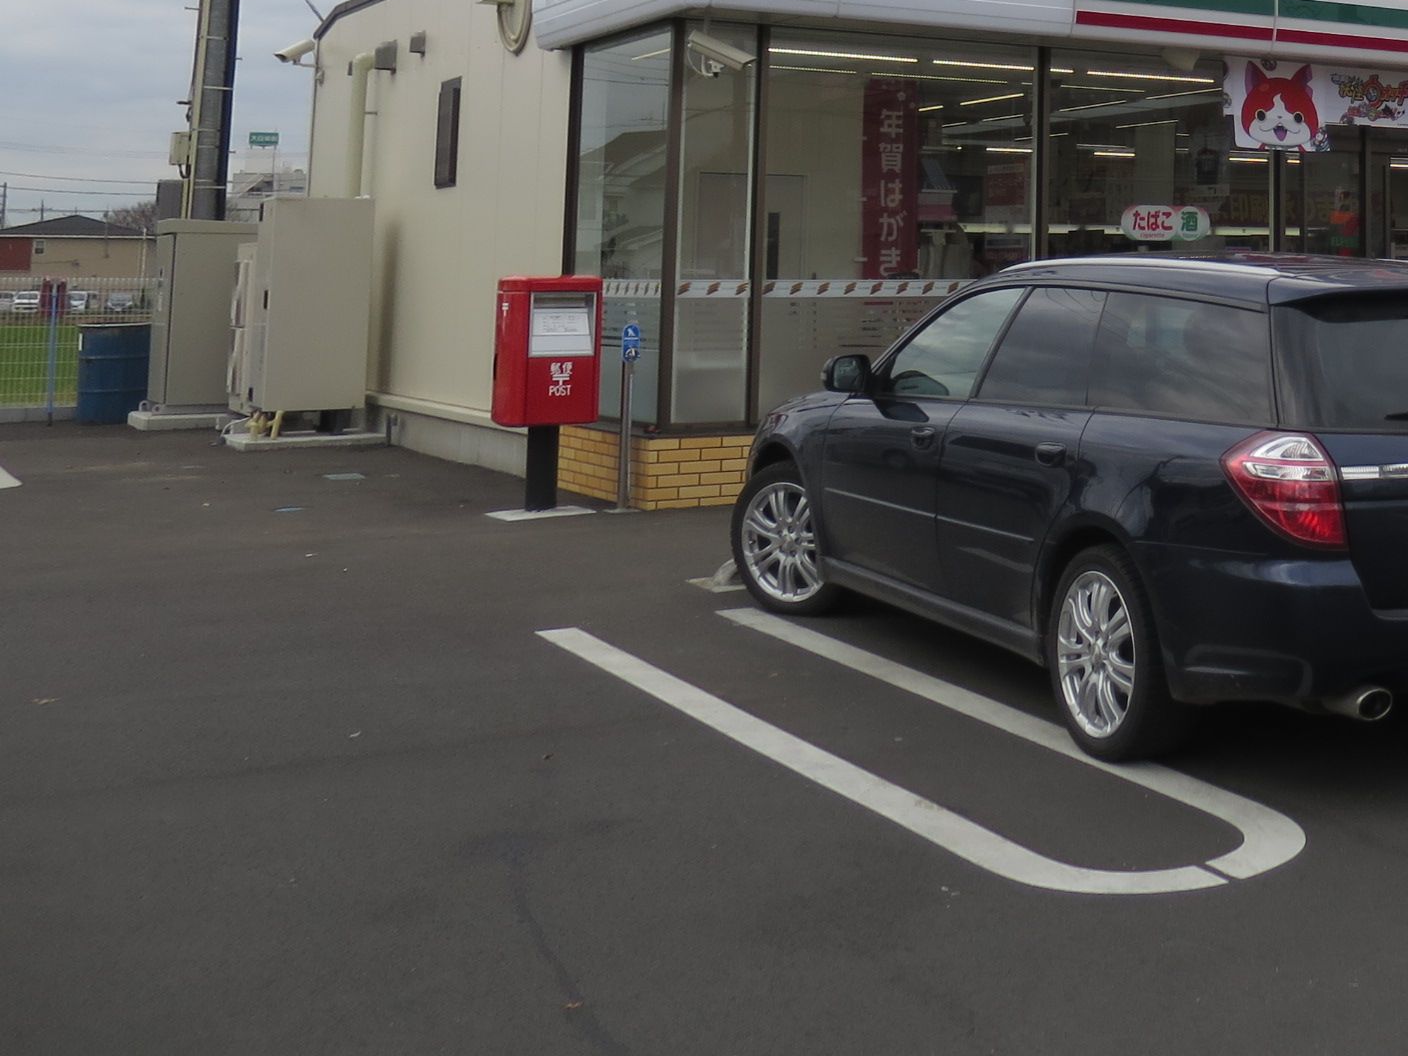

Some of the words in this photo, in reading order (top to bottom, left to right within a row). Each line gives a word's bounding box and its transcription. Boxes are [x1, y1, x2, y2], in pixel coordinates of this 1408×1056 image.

[879, 108, 908, 279] 年賀はがき
[1132, 209, 1173, 232] たばこ
[1180, 211, 1199, 232] 酒
[550, 362, 573, 375] 郵便
[548, 385, 572, 397] POST
